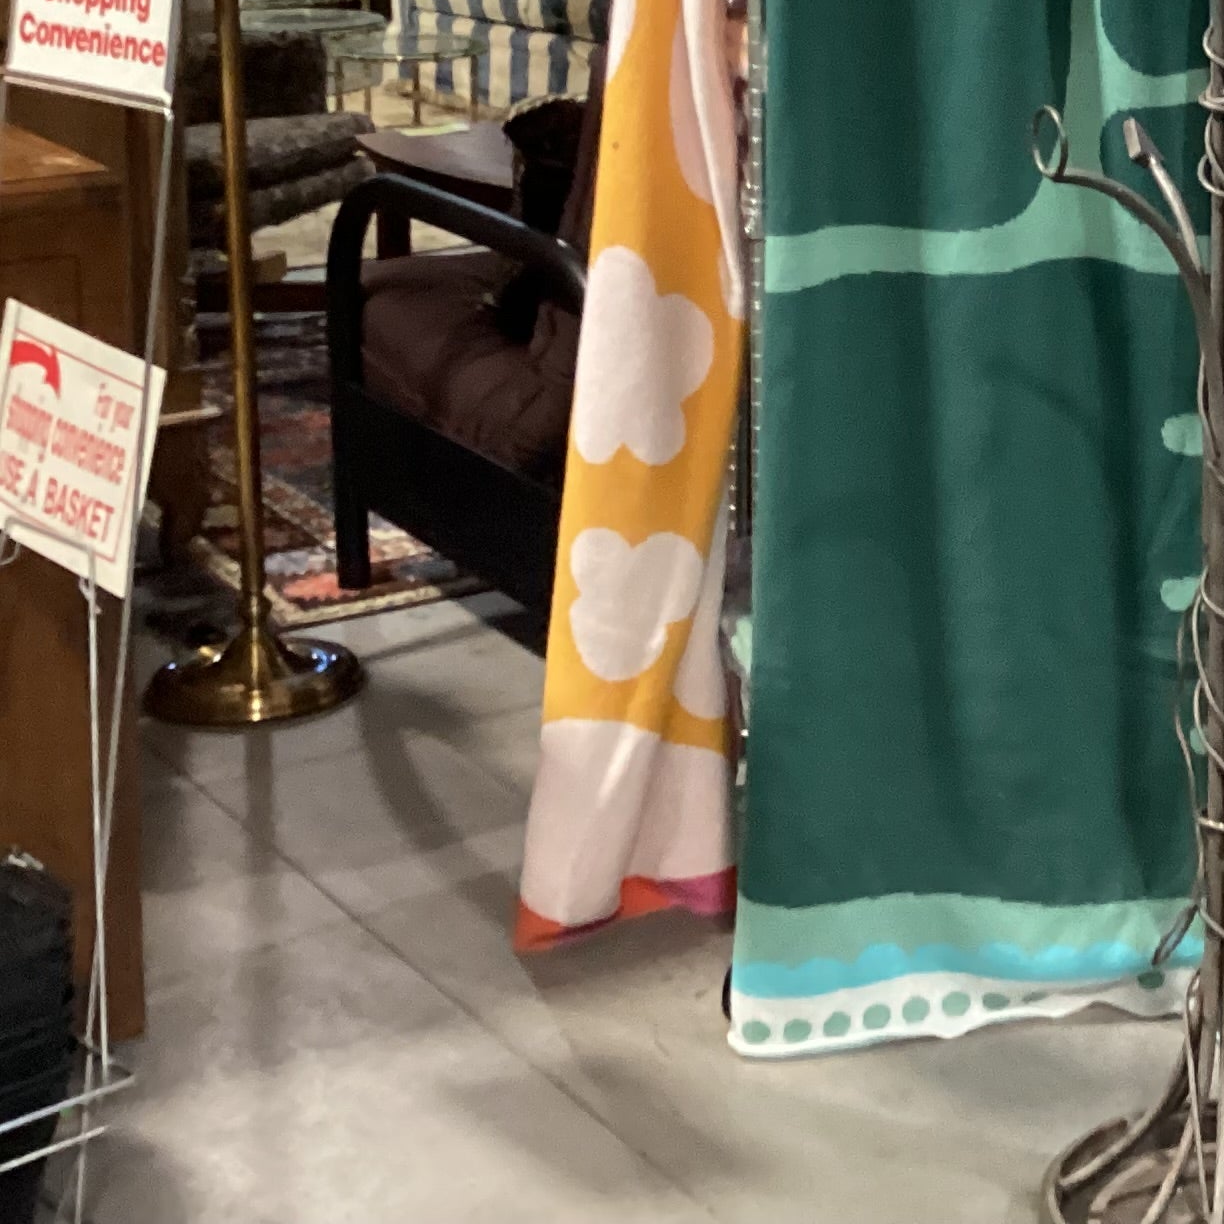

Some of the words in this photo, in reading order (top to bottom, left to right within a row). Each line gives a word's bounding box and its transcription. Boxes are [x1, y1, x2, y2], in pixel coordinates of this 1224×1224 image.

[18, 10, 166, 67] Convenience
[21, 467, 39, 506] A
[43, 476, 115, 543] BASKET
